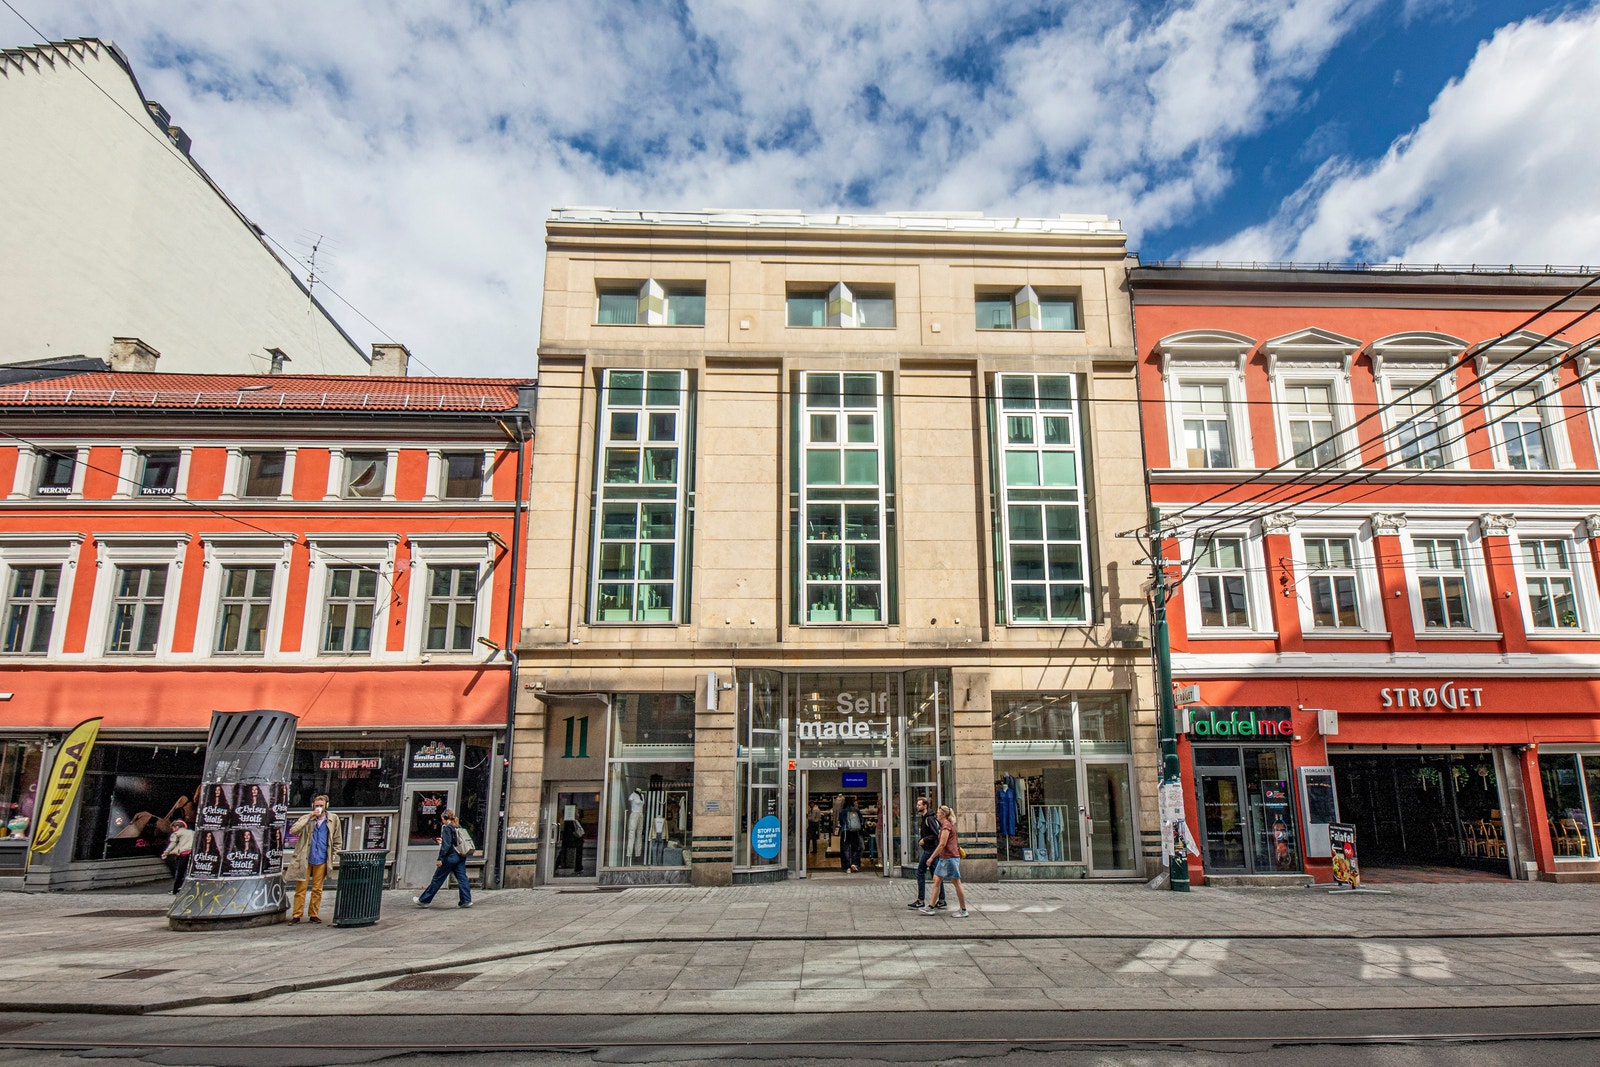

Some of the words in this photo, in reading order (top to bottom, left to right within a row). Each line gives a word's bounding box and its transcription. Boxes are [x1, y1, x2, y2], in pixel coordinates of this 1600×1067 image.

[836, 692, 887, 714] Self
[1381, 681, 1483, 709] STRØGET
[562, 716, 590, 759] 11
[36, 742, 87, 846] CALIDA
[1330, 830, 1354, 843] Falafel
